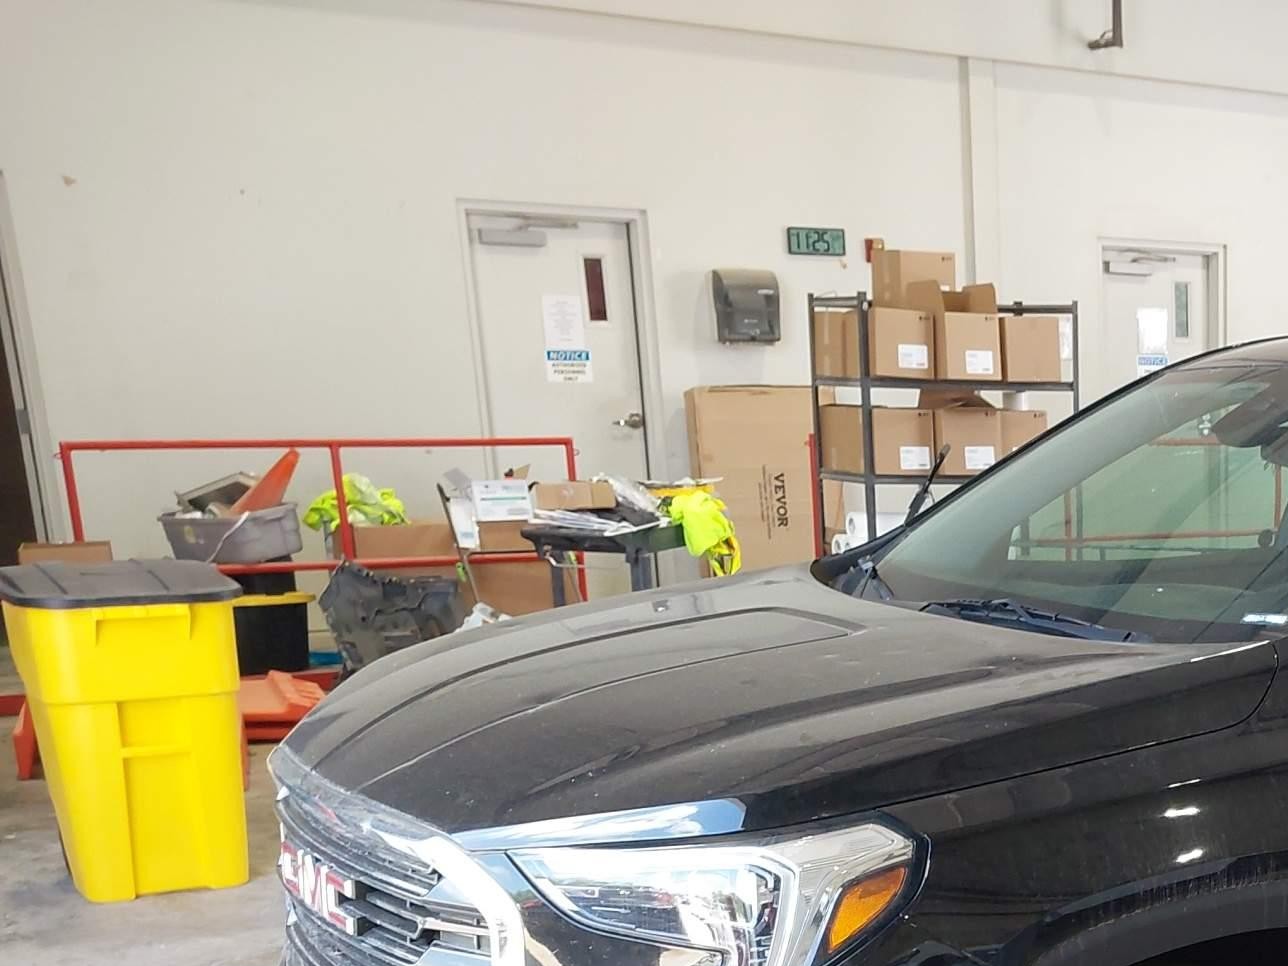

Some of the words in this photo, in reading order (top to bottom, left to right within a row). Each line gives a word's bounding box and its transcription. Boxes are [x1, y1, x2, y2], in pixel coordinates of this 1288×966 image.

[549, 351, 587, 360] NOTICE
[774, 473, 789, 528] VEVOR
[279, 840, 356, 937] GMC
